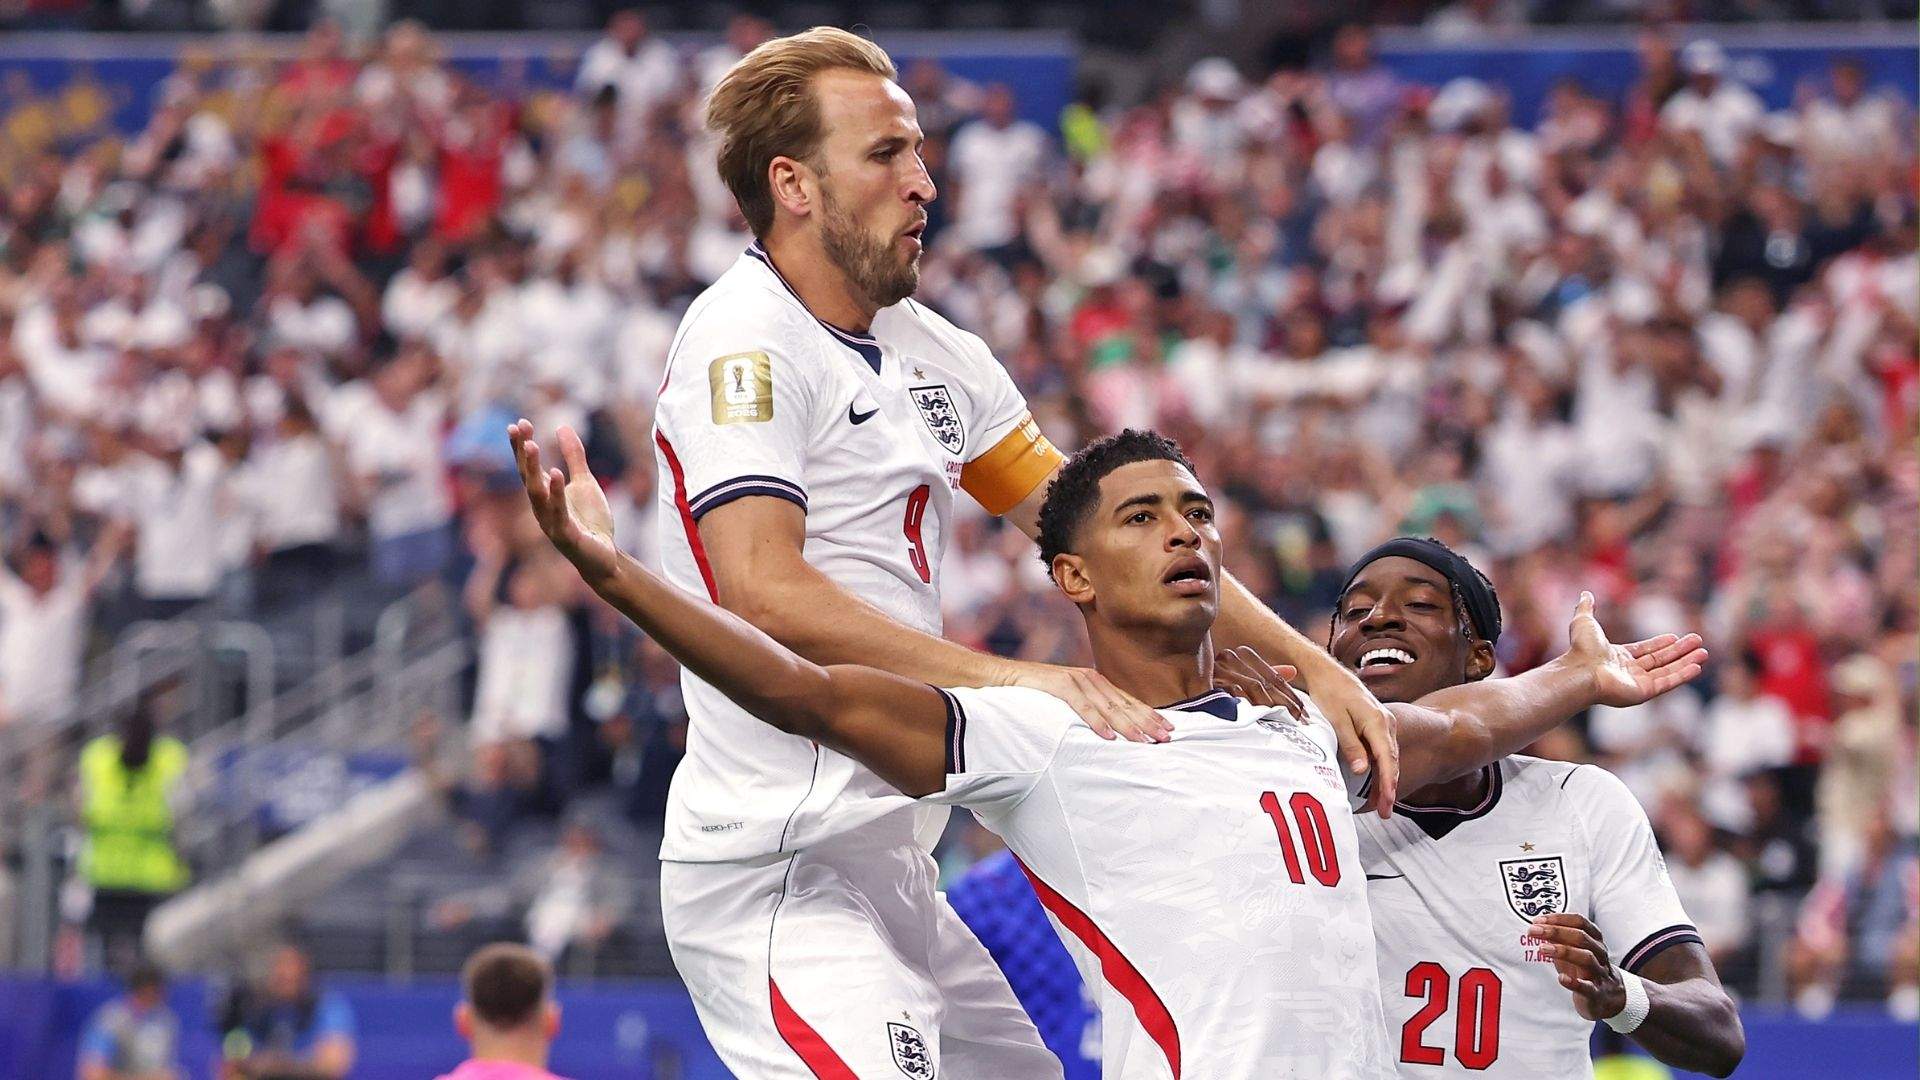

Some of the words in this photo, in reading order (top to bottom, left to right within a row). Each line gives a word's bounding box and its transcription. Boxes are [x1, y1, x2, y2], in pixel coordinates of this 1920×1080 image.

[903, 485, 930, 584] 9
[1259, 791, 1341, 888] 10
[1400, 961, 1502, 1070] 20
